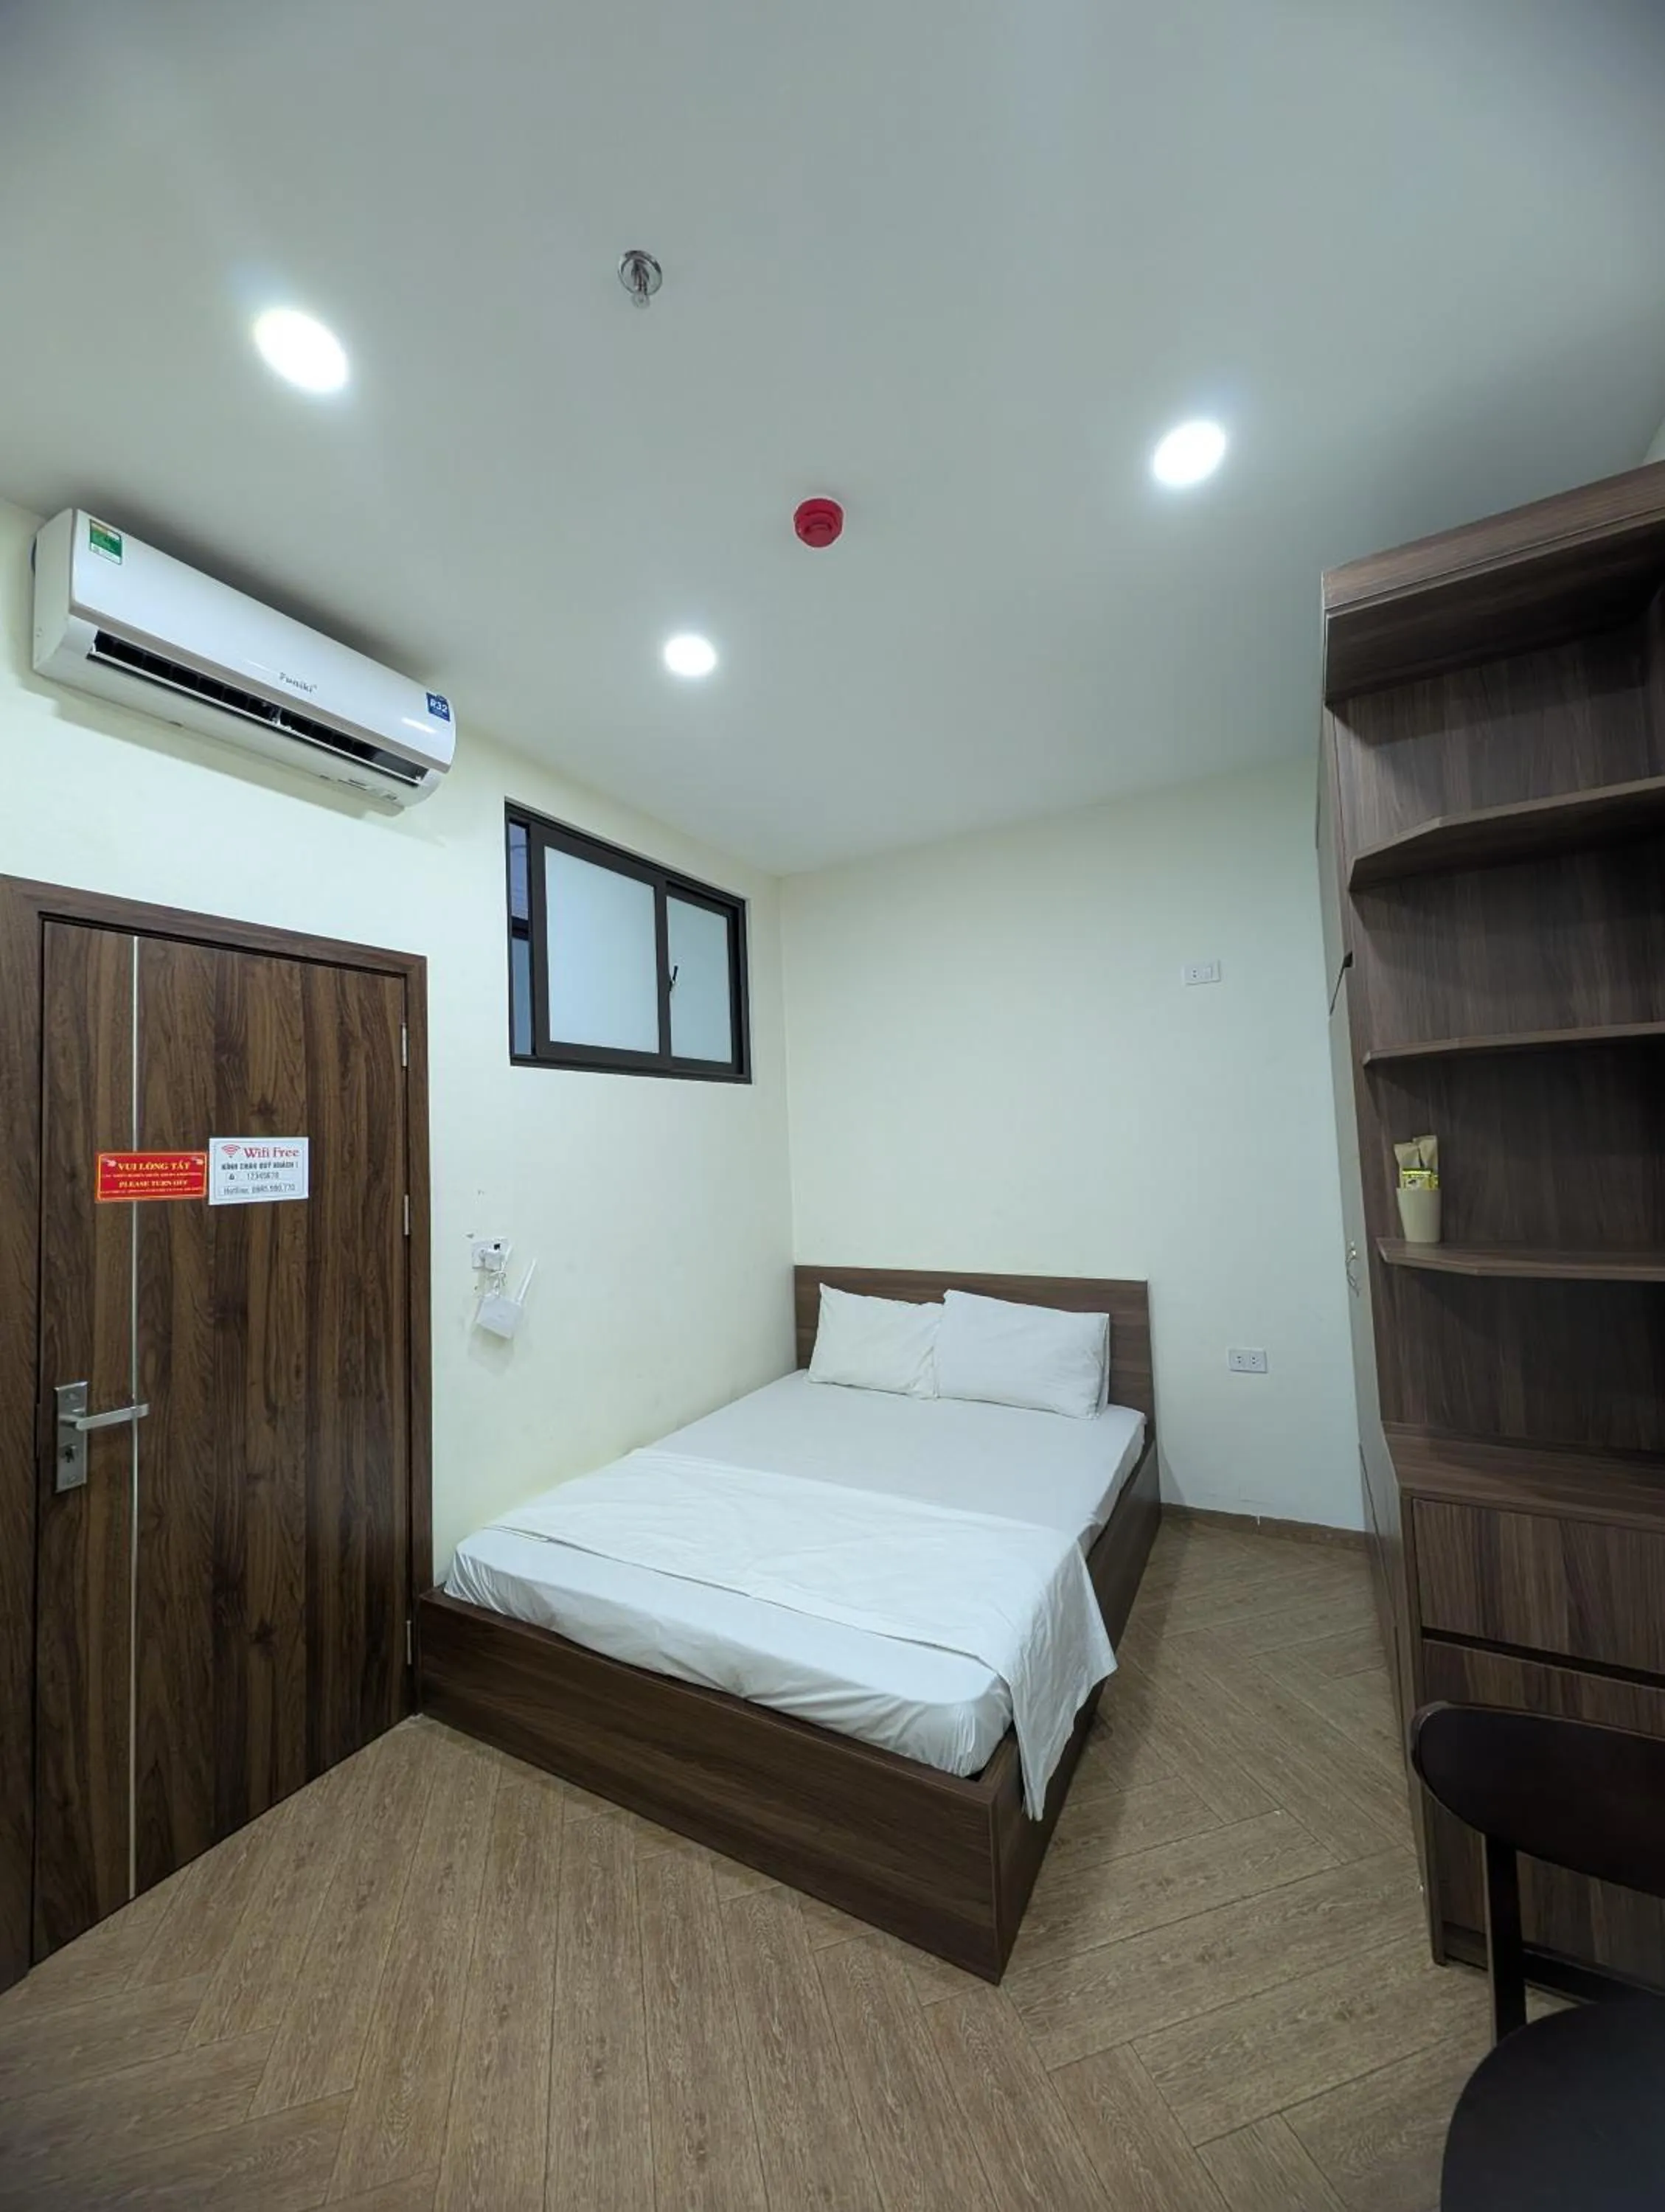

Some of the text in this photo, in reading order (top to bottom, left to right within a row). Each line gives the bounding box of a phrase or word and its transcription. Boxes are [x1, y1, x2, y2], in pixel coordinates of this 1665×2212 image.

[243, 1146, 300, 1158] Wifi Free
[118, 1162, 138, 1170] VUI
